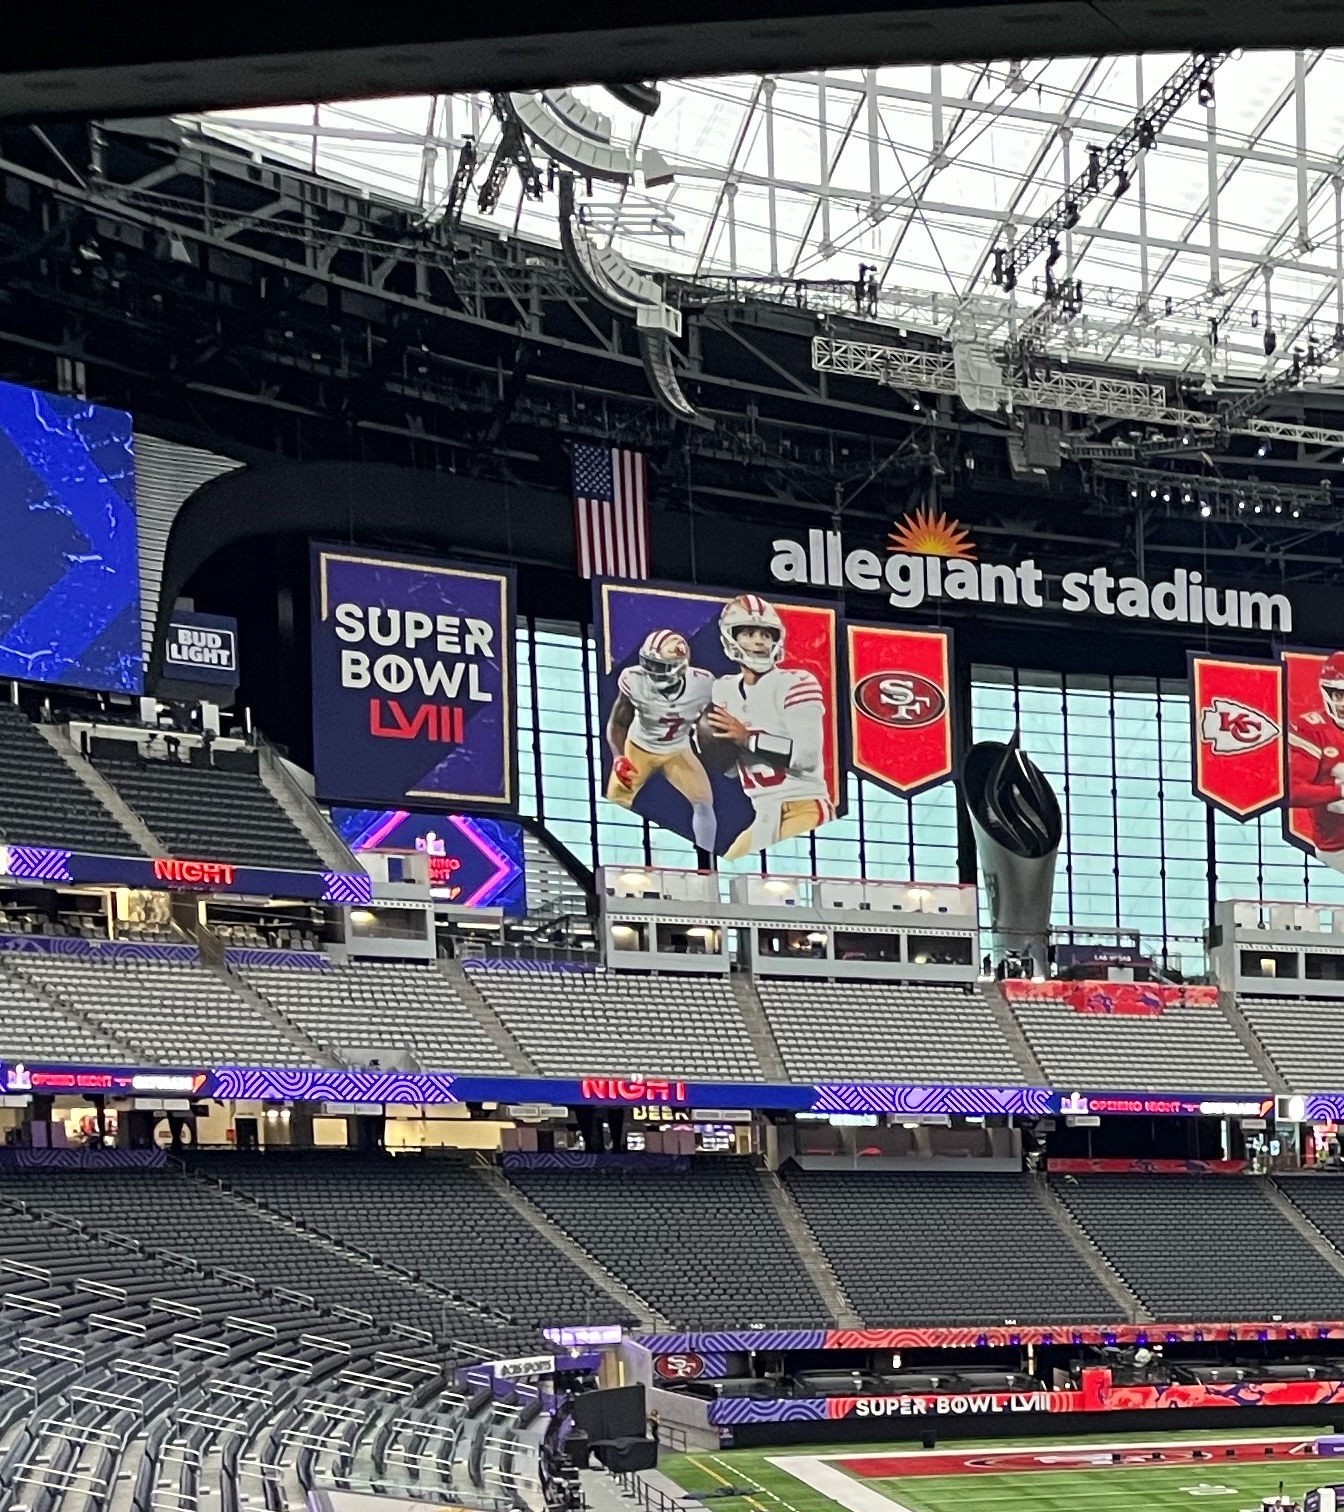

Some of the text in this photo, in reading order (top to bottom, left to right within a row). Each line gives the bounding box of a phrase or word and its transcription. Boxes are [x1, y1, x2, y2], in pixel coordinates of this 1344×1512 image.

[771, 528, 1293, 632] allegiant stadium
[178, 629, 222, 649] BUD
[335, 603, 494, 657] SUPER
[170, 643, 230, 666] LIGHT
[340, 649, 493, 702] BOWL
[370, 699, 464, 745] LVIII
[153, 858, 236, 885] NIGHT
[582, 1078, 687, 1101] NIGHT
[855, 1392, 1050, 1417] SUPER BOWL LVIII
